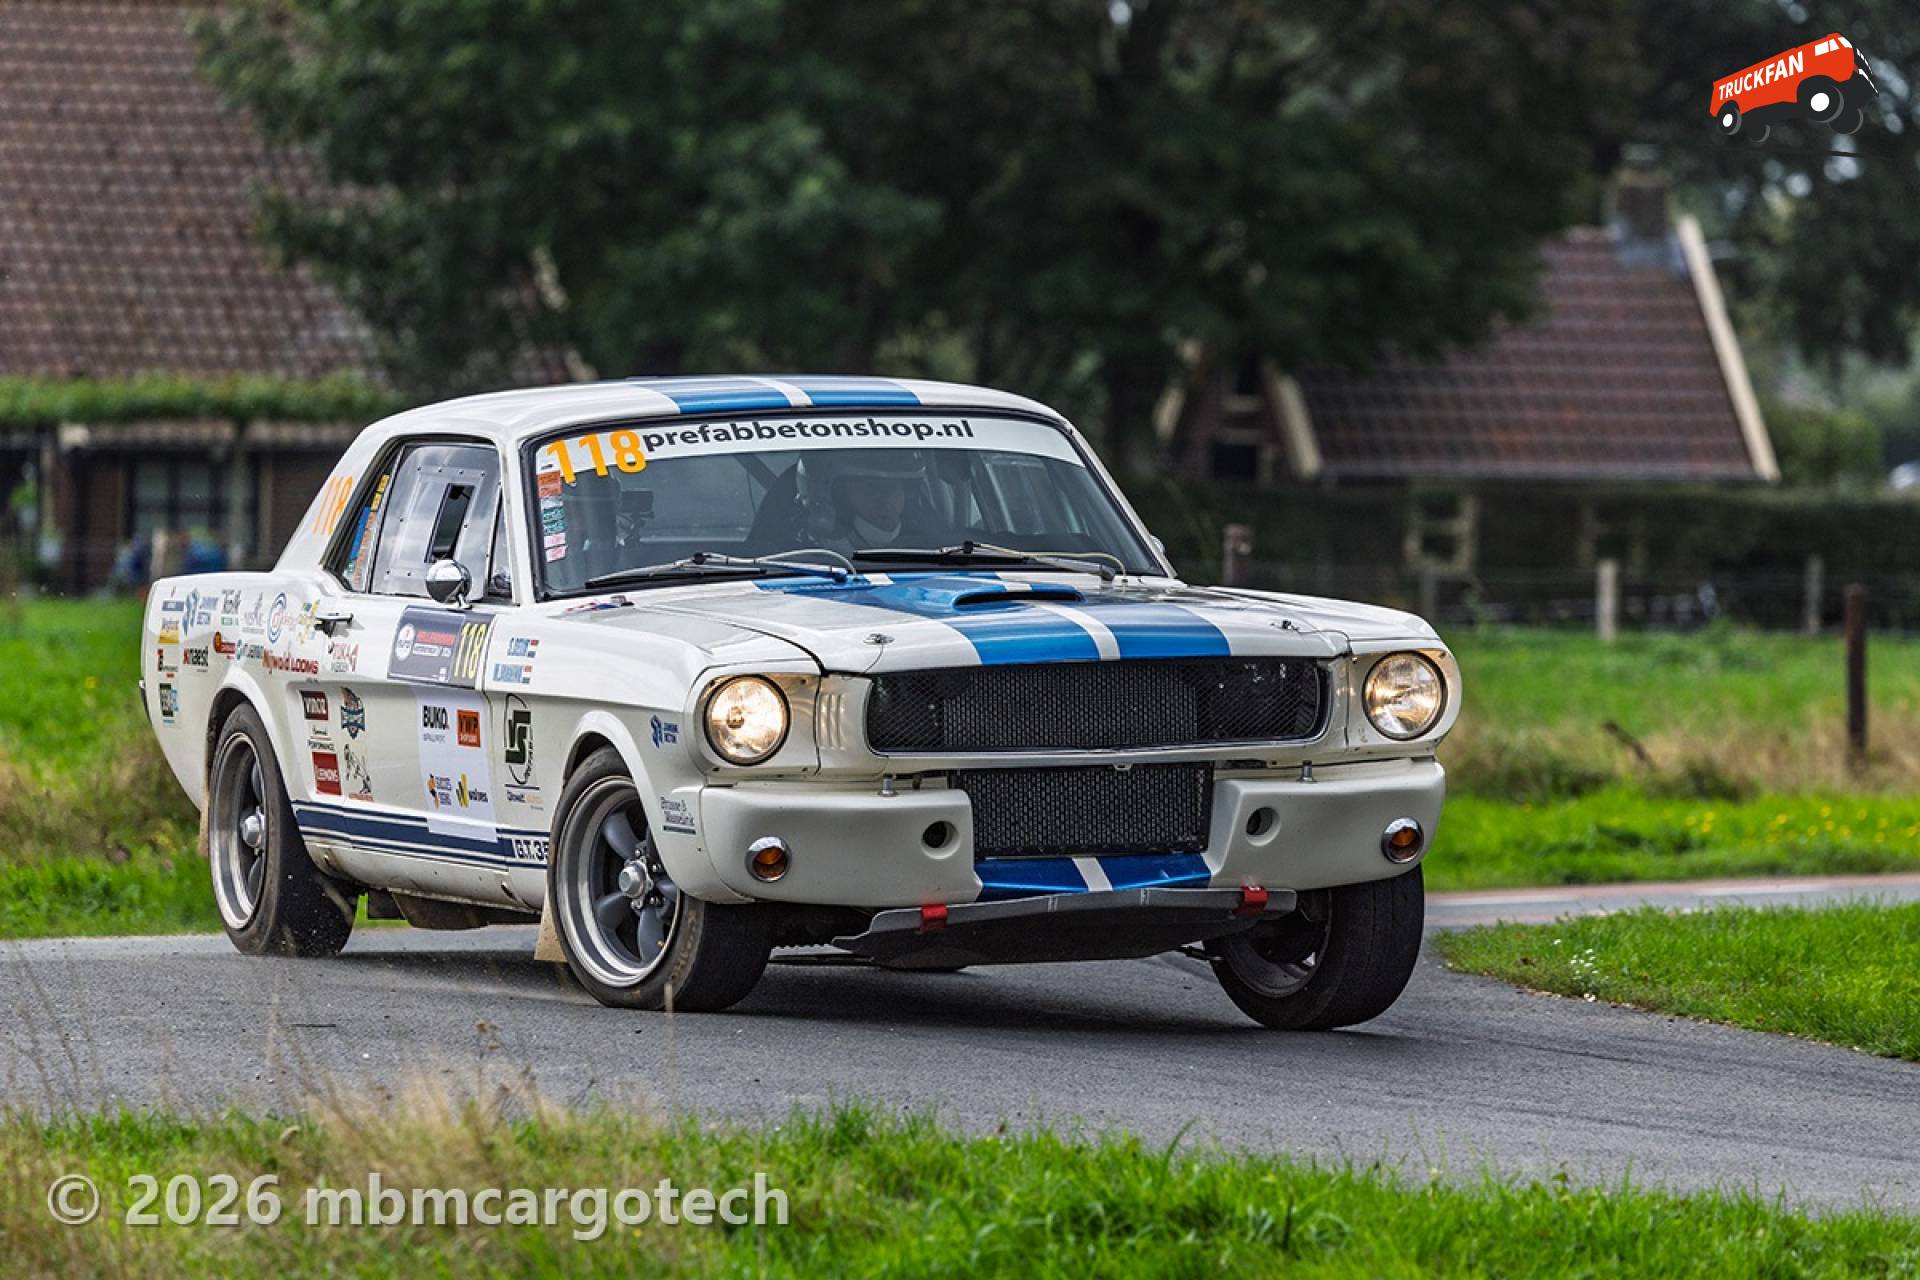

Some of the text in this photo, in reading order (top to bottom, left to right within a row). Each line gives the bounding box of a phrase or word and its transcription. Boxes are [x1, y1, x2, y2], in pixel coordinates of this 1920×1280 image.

[547, 429, 647, 484] 118
[641, 418, 974, 452] prefabbetonshop.nl
[312, 476, 353, 535] 118
[291, 658, 319, 674] LOOMS
[453, 622, 488, 680] 118
